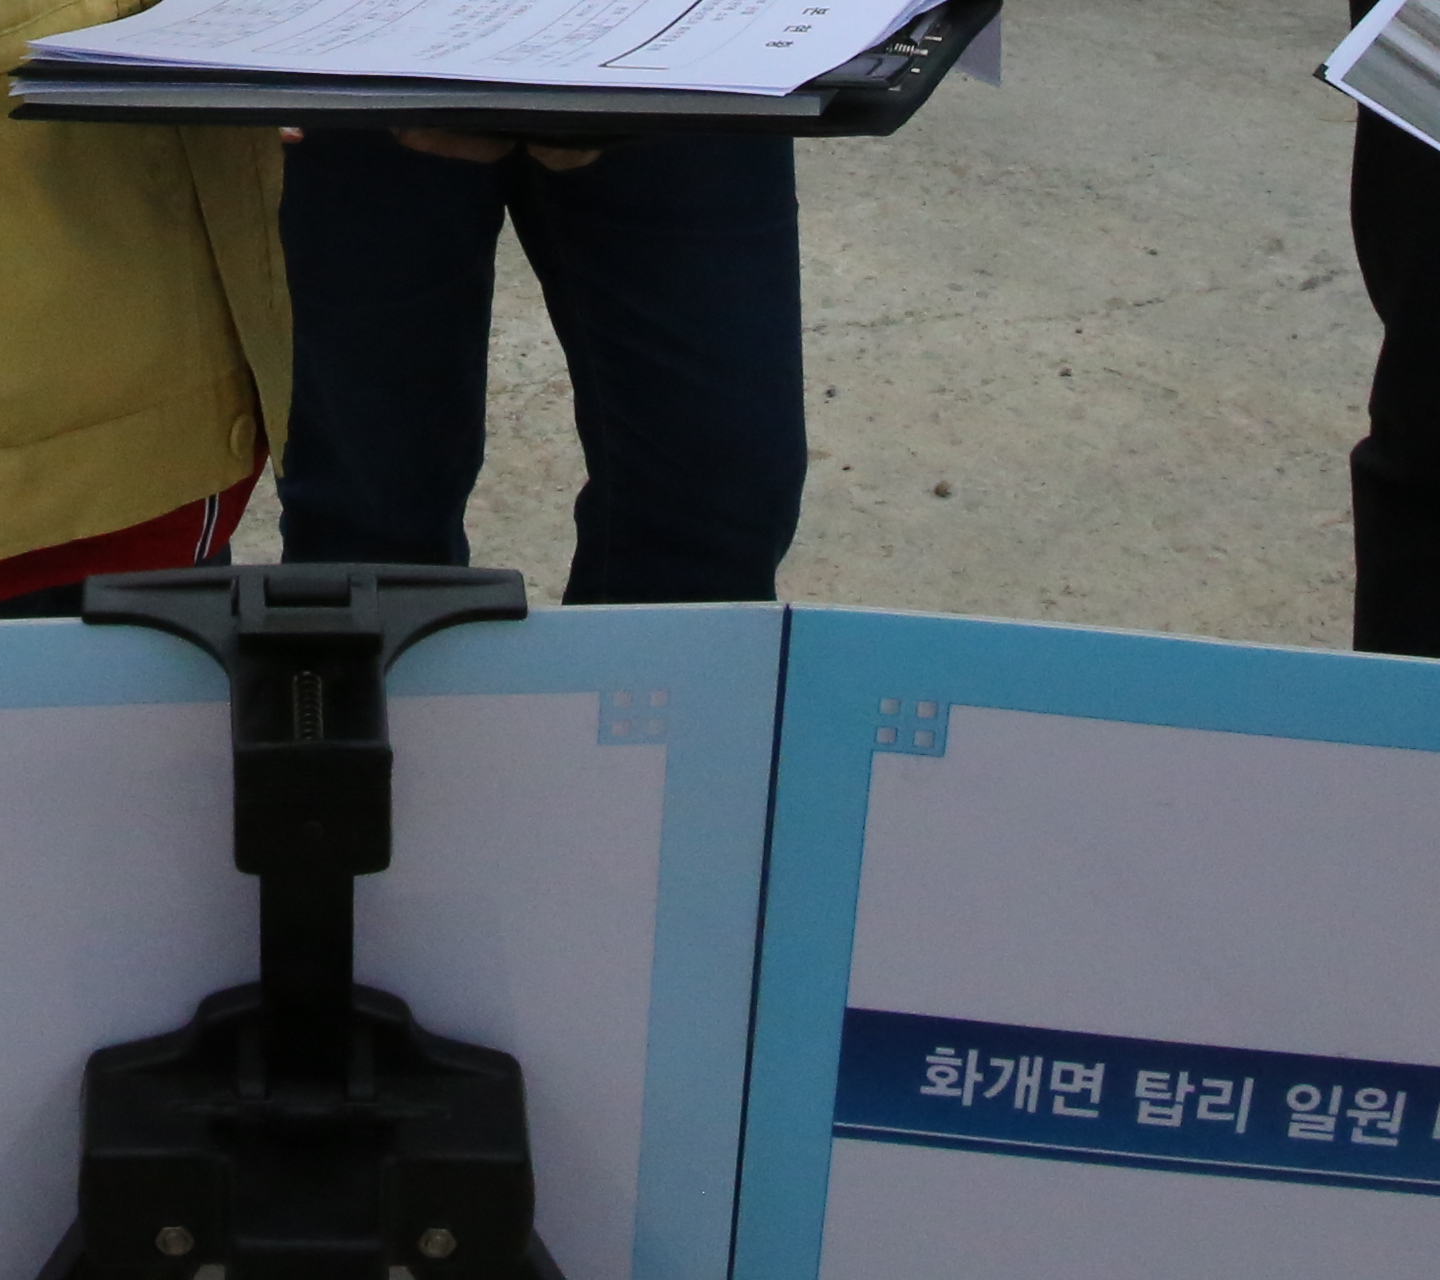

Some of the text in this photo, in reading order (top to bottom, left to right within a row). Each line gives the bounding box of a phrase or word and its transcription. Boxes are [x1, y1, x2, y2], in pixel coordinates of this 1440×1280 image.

[919, 1046, 1106, 1121] 화개면
[1132, 1068, 1254, 1135] 탑리
[1284, 1083, 1407, 1148] 일원
